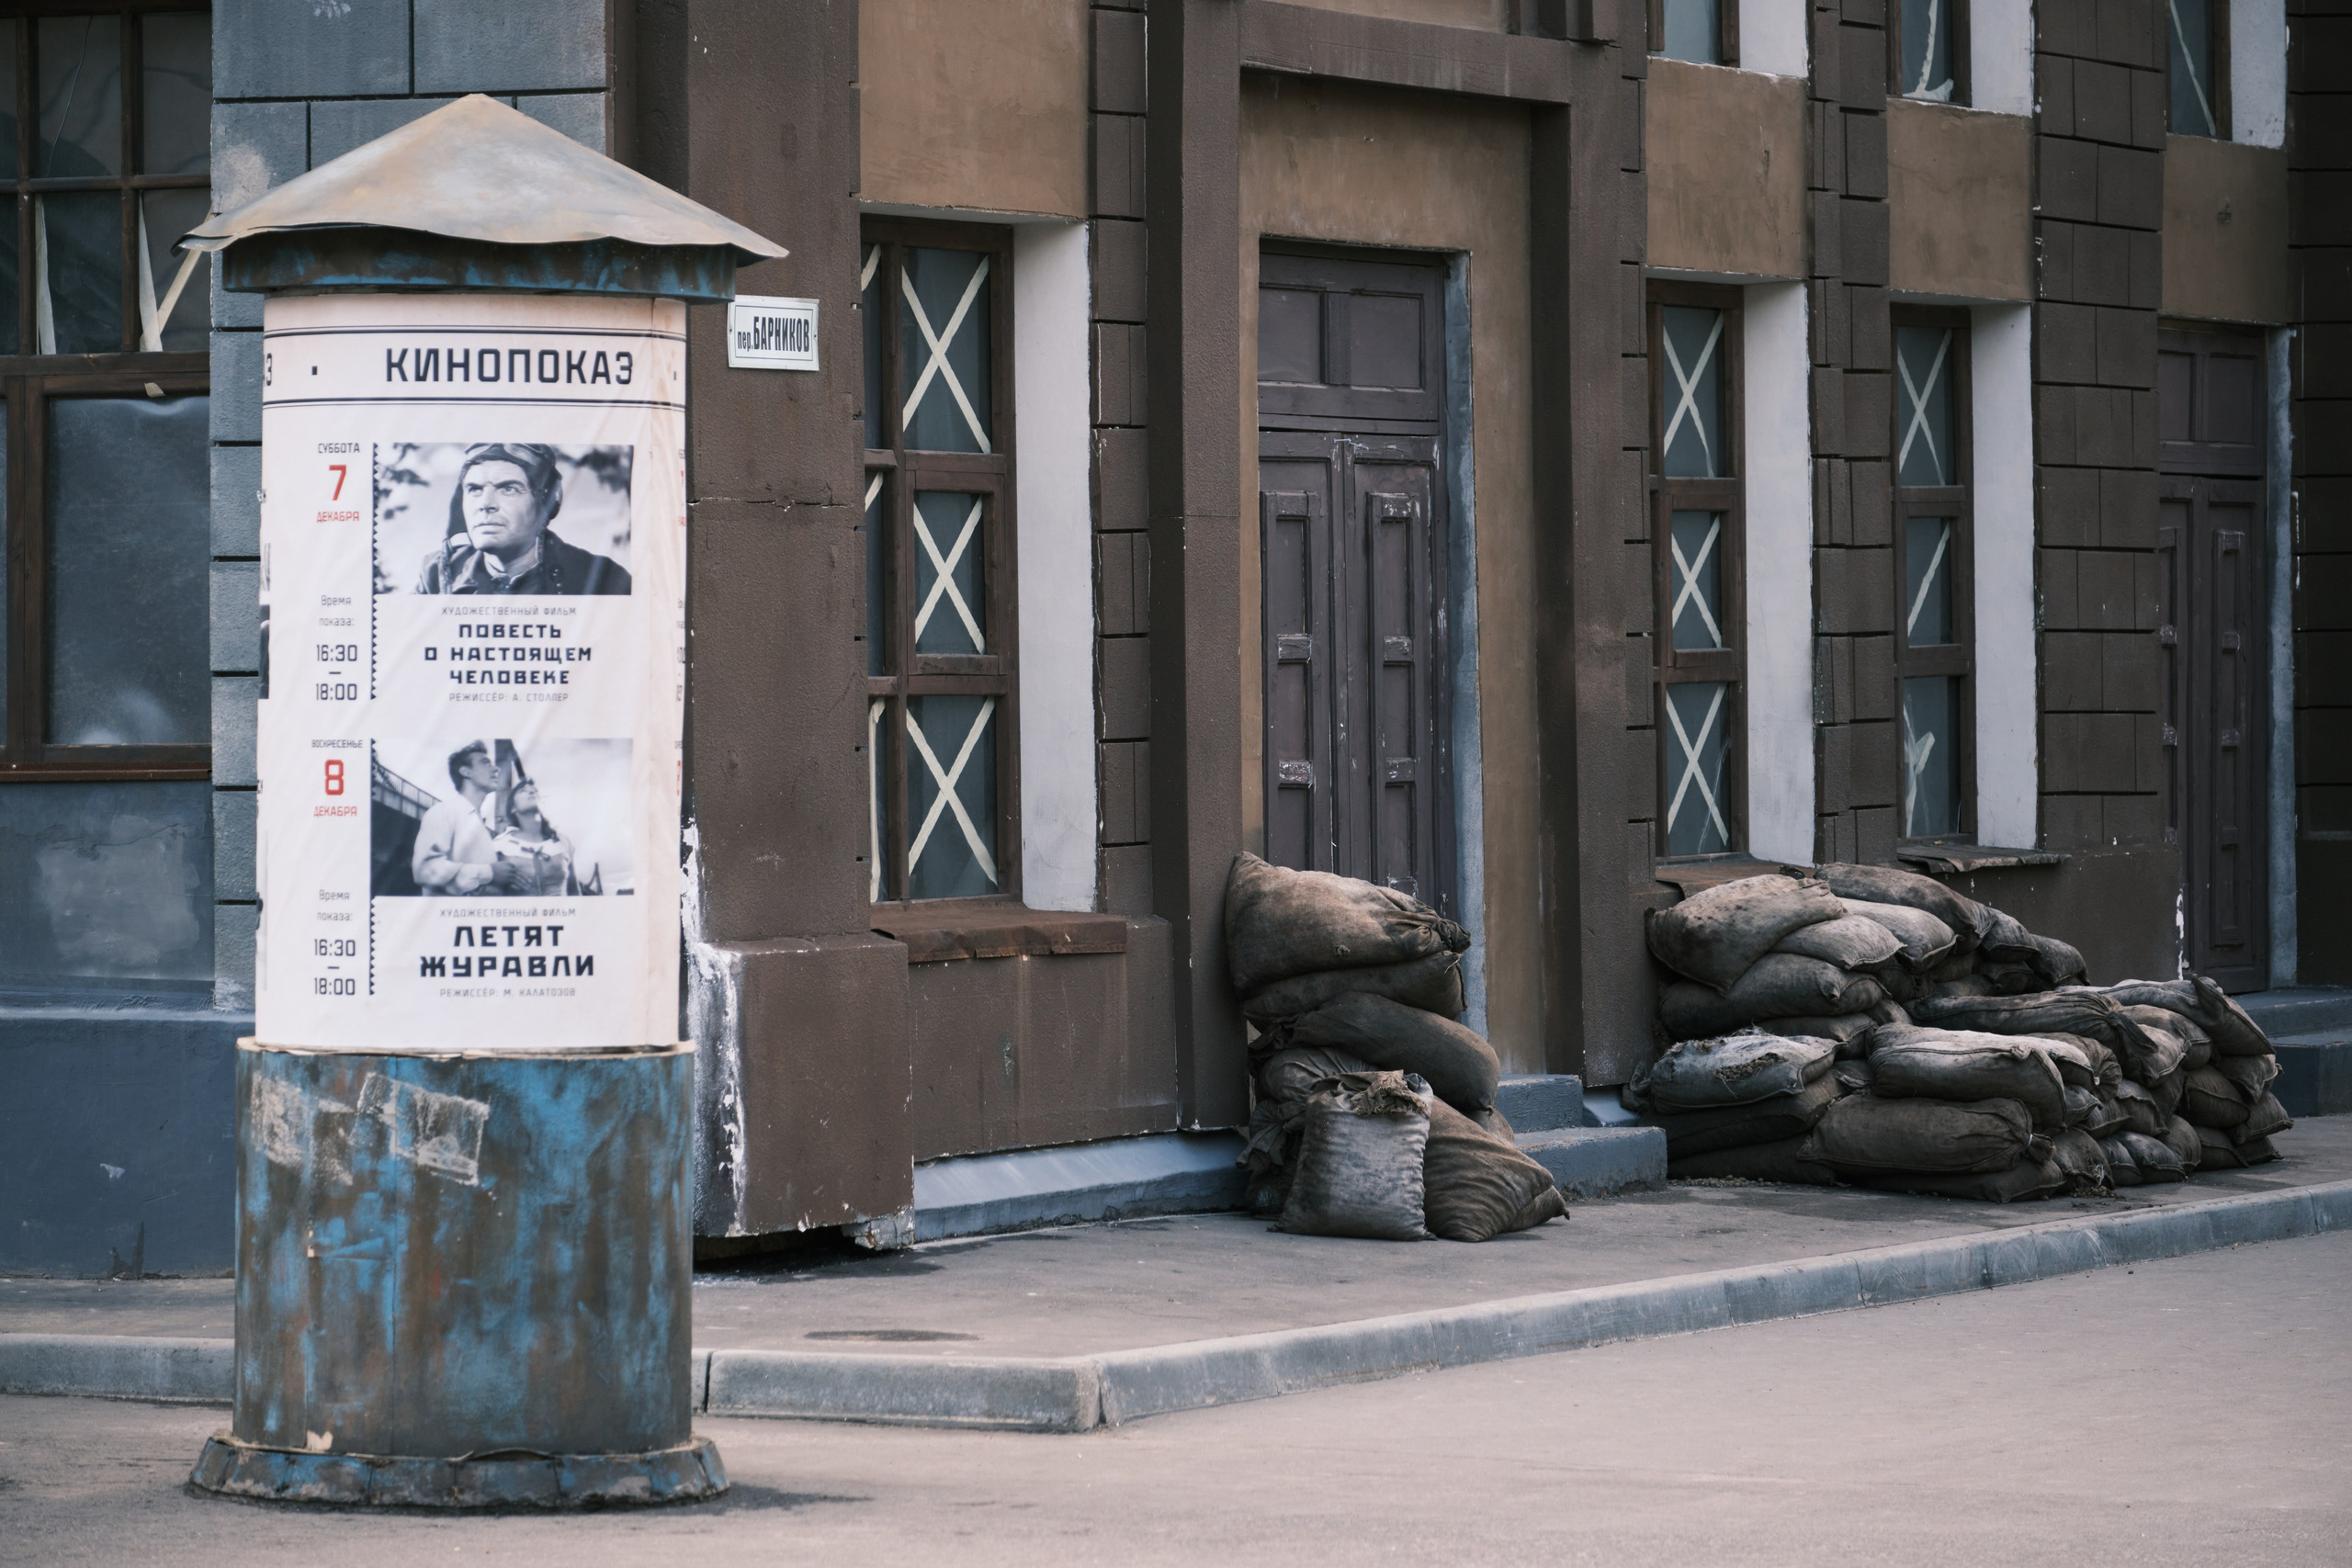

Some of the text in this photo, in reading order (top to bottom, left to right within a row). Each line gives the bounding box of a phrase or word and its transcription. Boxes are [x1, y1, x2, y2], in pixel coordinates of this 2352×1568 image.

[386, 347, 633, 385] КИНОПОКАЗ
[318, 443, 360, 454] СУББОТА
[329, 464, 346, 501] 7
[316, 511, 360, 524] ДЕКАБРЯ
[321, 594, 352, 606] Время
[441, 605, 577, 615] ХУДОЖЕСТВЕННЫЙ ФИЛЬМ
[319, 617, 355, 626] показа:
[458, 624, 561, 638] ПОВЕСТЬ
[316, 644, 357, 661] 16:30
[424, 647, 592, 664] О НАСТОЯЩЕМ
[449, 670, 570, 684] ЧЕЛОВЕКЕ
[316, 682, 357, 700] 18:00
[512, 693, 522, 702] А.
[526, 693, 569, 702] СТОЛПЕР
[311, 739, 363, 749] ВОСКРЕСЕНЬЕ
[324, 759, 344, 795] 8
[313, 806, 357, 818] ДЕКАБРЯ
[319, 888, 350, 901] Время
[317, 911, 353, 921] показа:
[439, 907, 576, 918] ХУДОЖЕСТВЕННЫЙ ФИЛЬМ
[453, 926, 564, 947] ЛЕТЯТ
[314, 939, 356, 956] 16:30
[420, 954, 594, 977] ЖУРАВЛИ
[314, 977, 356, 995] 18:00
[503, 987, 514, 998] М.
[519, 987, 576, 998] КАЛАТОЗОВ
